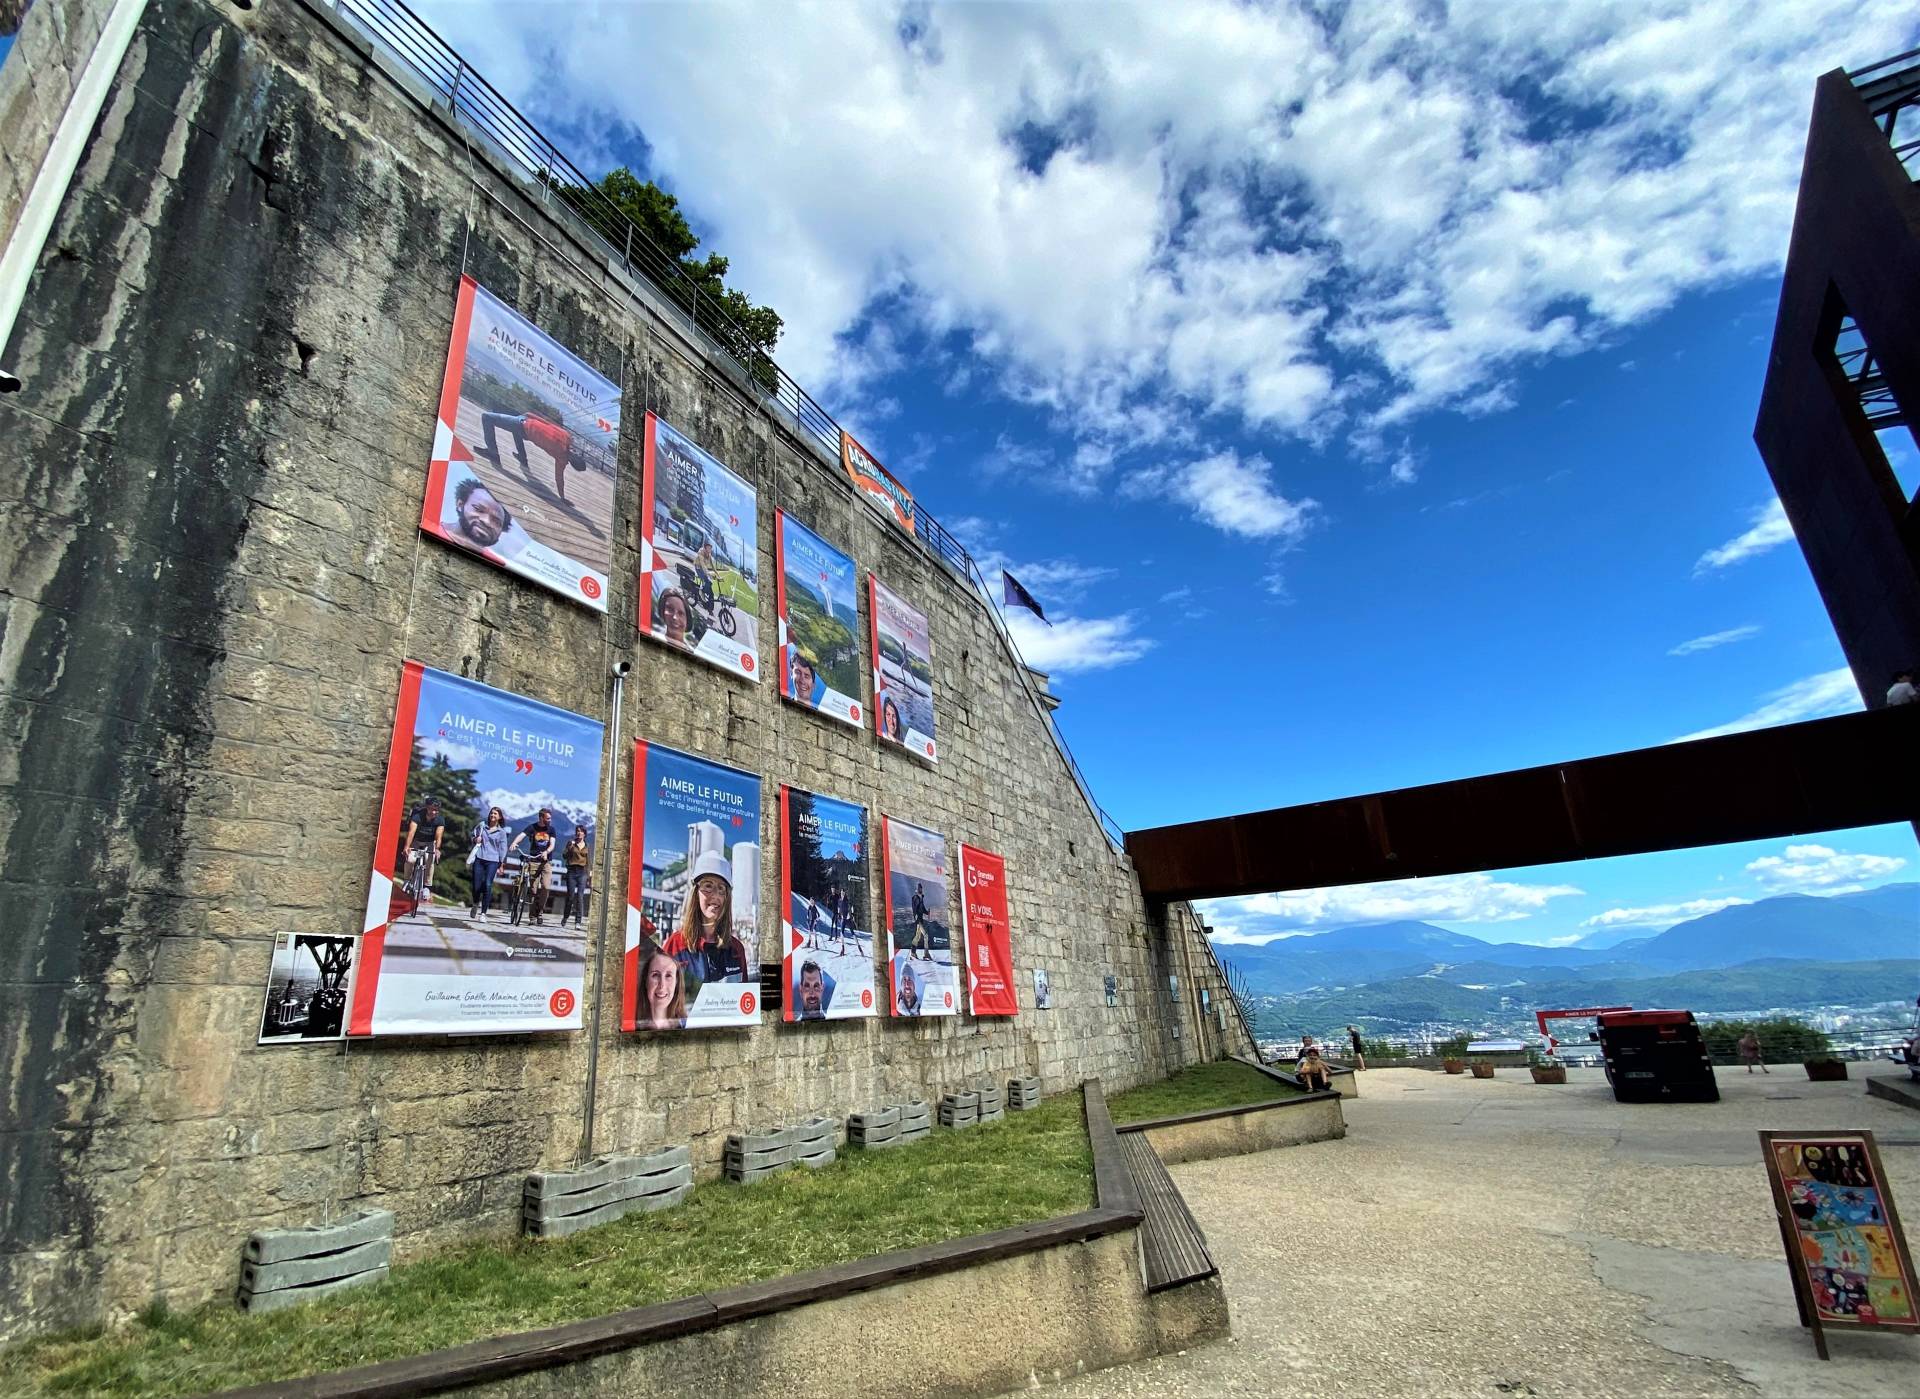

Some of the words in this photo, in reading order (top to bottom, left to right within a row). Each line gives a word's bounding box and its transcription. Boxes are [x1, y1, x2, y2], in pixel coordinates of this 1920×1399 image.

[490, 326, 535, 361] AIMER
[539, 357, 556, 375] LE
[558, 370, 597, 404] FUTUR
[668, 450, 698, 477] AIMER
[791, 539, 813, 558] AIMER
[440, 711, 496, 738] AIMER
[502, 727, 521, 745] LE
[526, 734, 575, 758] FUTUR
[447, 730, 474, 744] C'est
[526, 750, 546, 763] plus
[548, 755, 569, 768] beau
[660, 776, 695, 795] AIMER
[698, 785, 711, 799] LE
[713, 789, 743, 807] FUTUR
[665, 790, 682, 802] C'est
[683, 794, 711, 808] l'inventer
[712, 802, 719, 810] et
[727, 806, 755, 819] construire
[658, 799, 675, 808] avec
[676, 802, 685, 810] de
[686, 803, 705, 816] belles
[706, 808, 731, 820] énergies
[798, 812, 822, 827] AIMER
[824, 819, 833, 830] LE
[834, 821, 857, 835] FUTUR
[425, 991, 461, 1002] Guillaume
[489, 992, 518, 1001] Maxime
